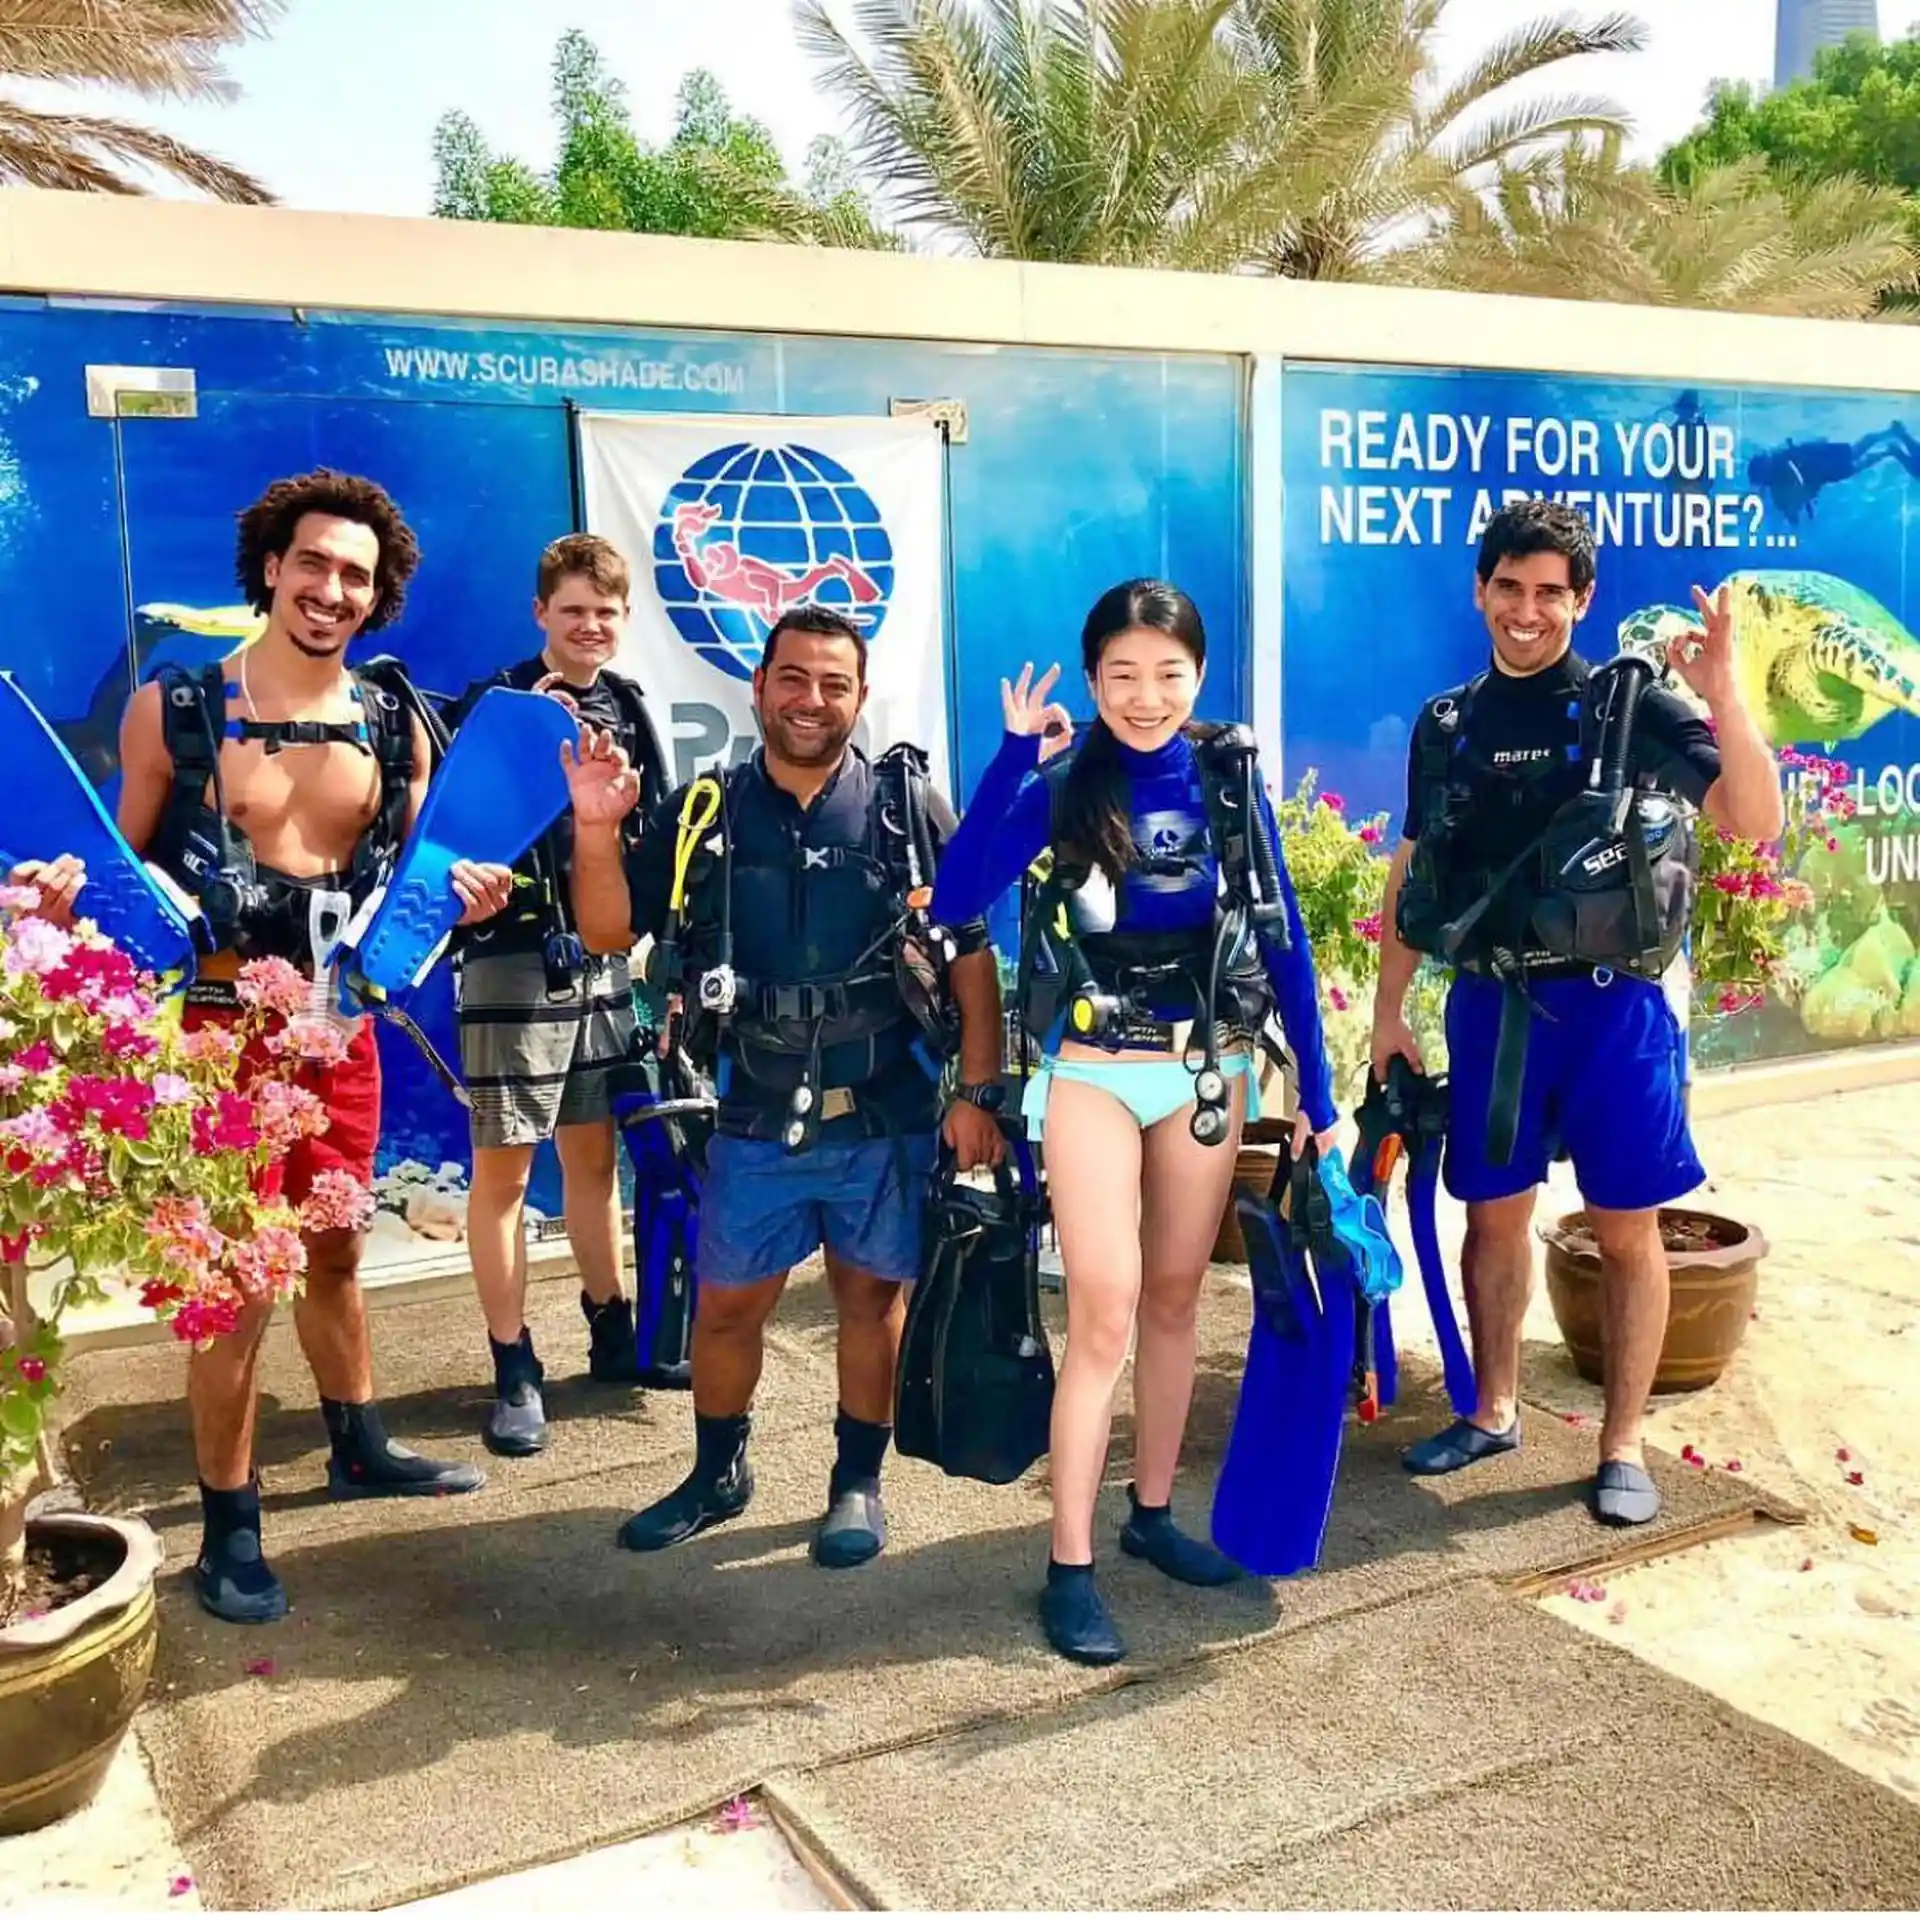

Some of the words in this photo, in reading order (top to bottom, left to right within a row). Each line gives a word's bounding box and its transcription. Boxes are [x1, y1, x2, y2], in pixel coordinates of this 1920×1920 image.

[385, 348, 744, 394] WWW.SCUBASHADE.COM
[1320, 410, 1490, 472] READY
[1507, 418, 1599, 475] FOR
[1618, 423, 1735, 479] YOUR
[1320, 486, 1451, 544] NEXT
[1466, 489, 1797, 548] ANTURE?...
[1867, 834, 1920, 884] UN
